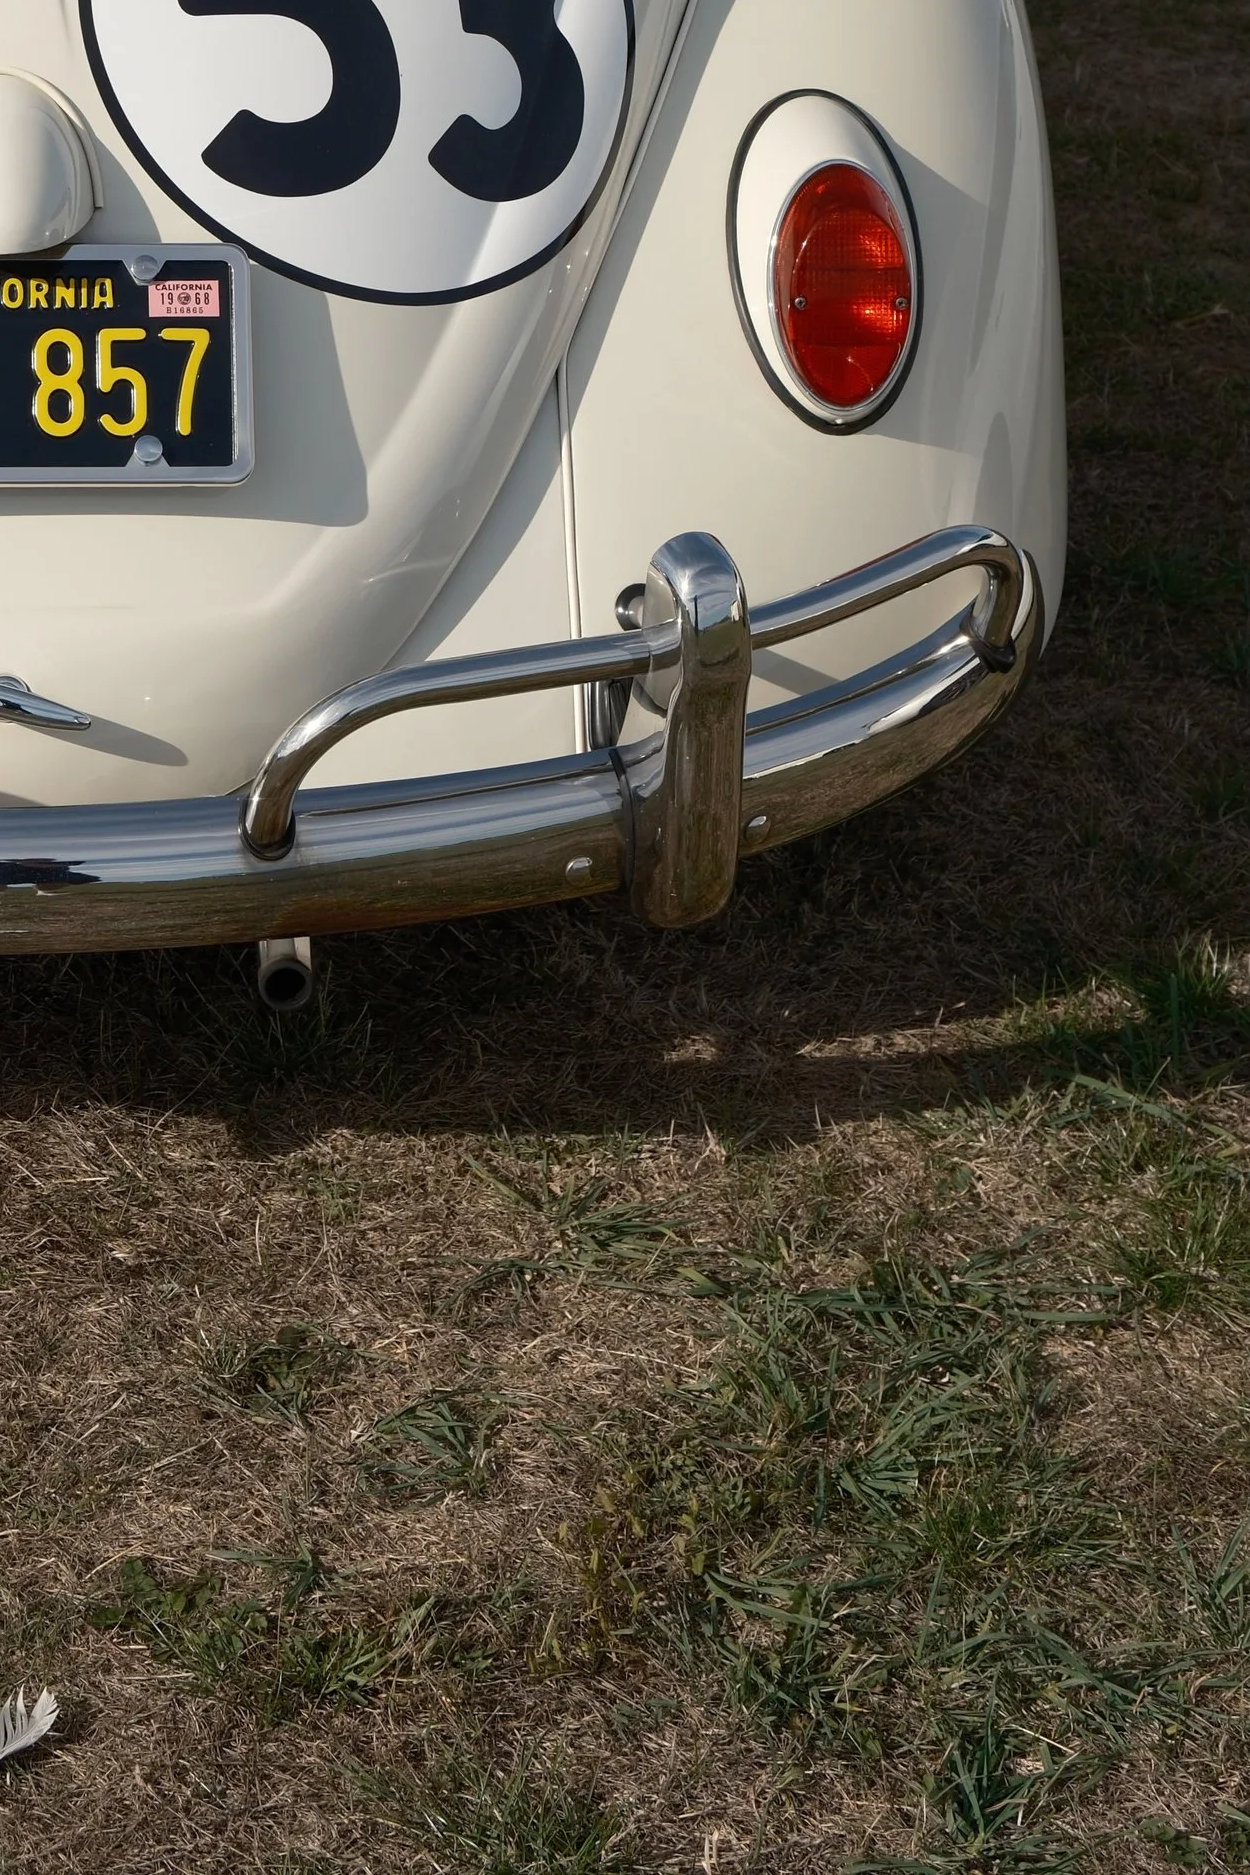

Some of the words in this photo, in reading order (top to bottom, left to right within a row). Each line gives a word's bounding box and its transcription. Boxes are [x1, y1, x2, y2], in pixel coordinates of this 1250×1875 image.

[155, 283, 213, 291] CALIFORNIA
[161, 291, 174, 306] 19
[194, 292, 210, 306] 68
[32, 328, 211, 437] 857
